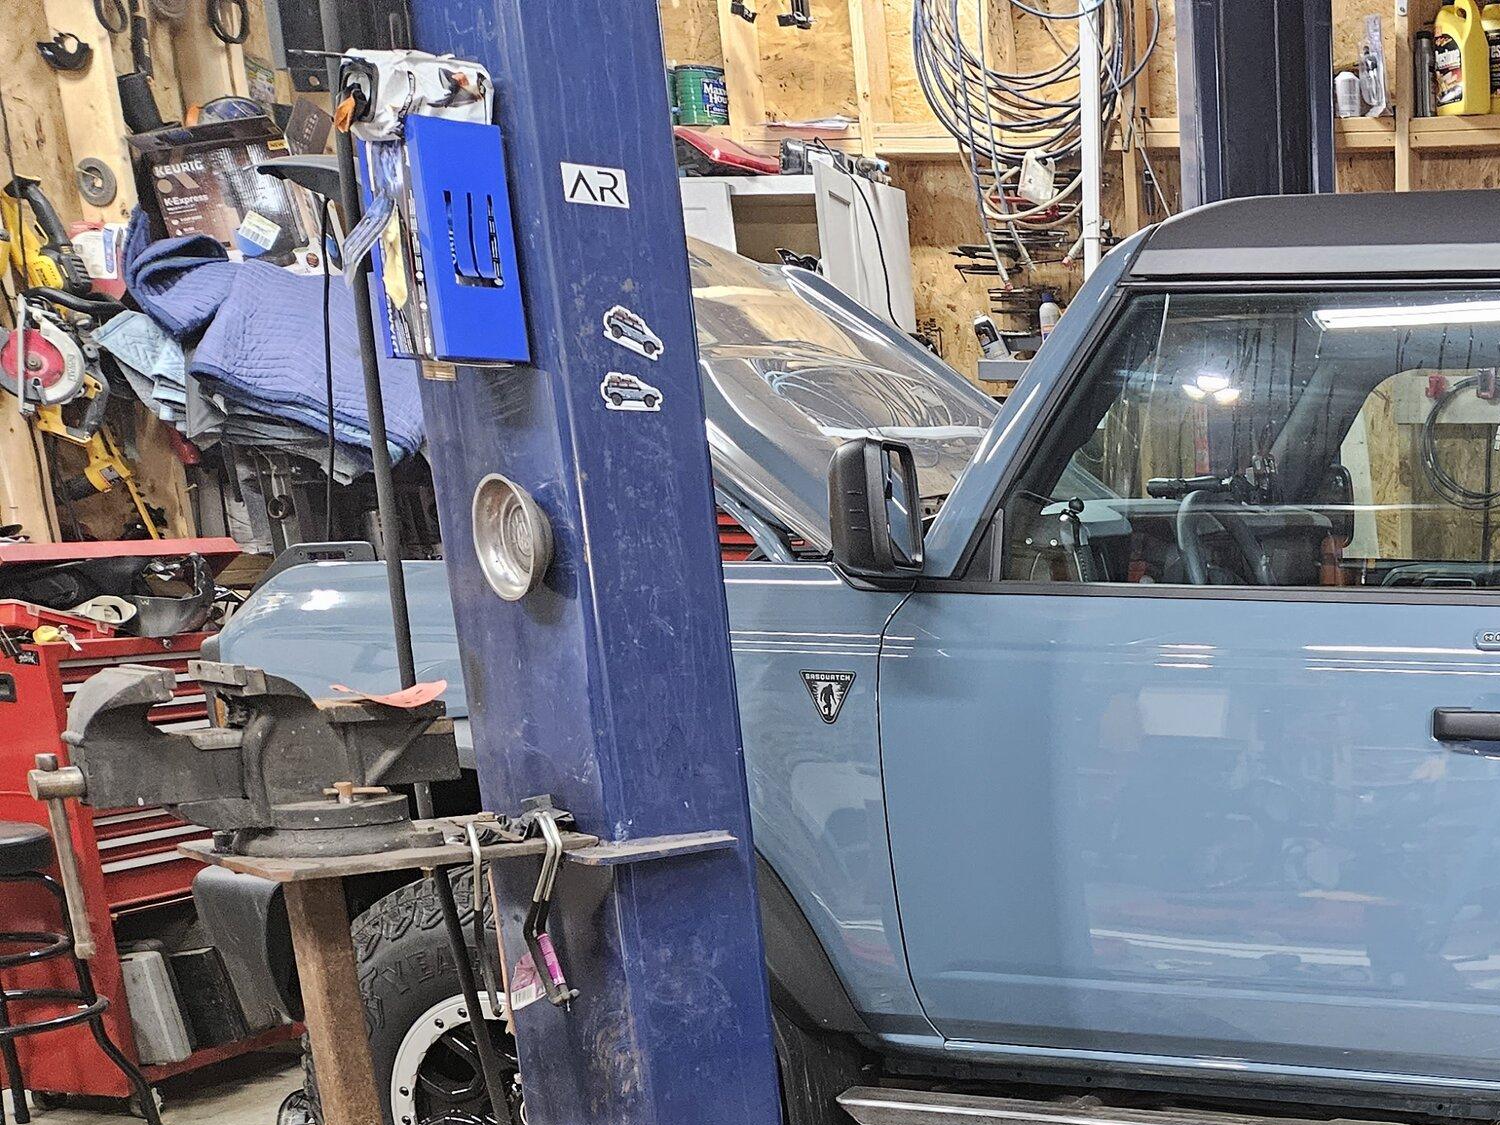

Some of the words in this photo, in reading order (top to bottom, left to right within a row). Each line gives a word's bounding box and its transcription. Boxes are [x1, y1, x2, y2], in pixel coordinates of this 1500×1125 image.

[154, 160, 204, 178] KEURIG
[569, 169, 625, 205] AR
[163, 193, 209, 208] K-Express
[805, 673, 851, 681] SASQUATCH
